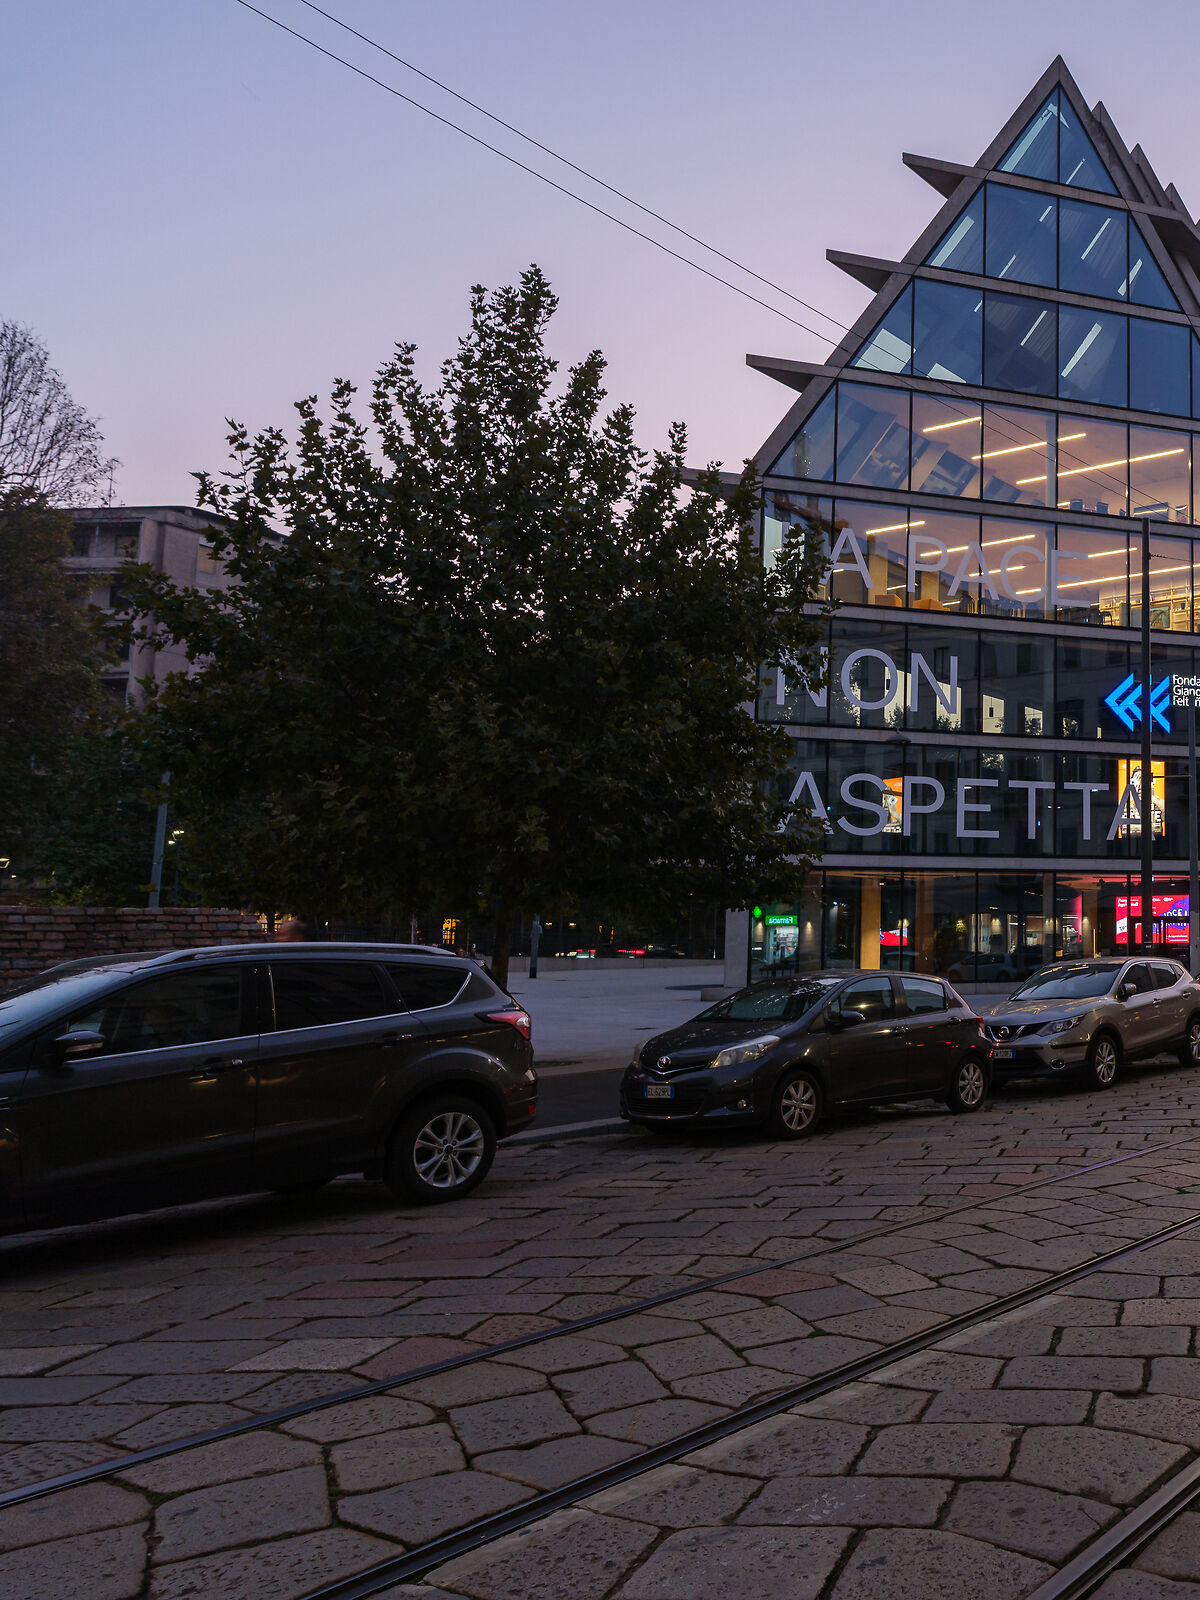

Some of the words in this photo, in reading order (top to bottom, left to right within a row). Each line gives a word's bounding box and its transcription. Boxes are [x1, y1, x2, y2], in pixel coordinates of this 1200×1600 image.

[907, 534, 1090, 608] PACE
[775, 646, 959, 715] NON
[775, 771, 1156, 842] ASPETTA
